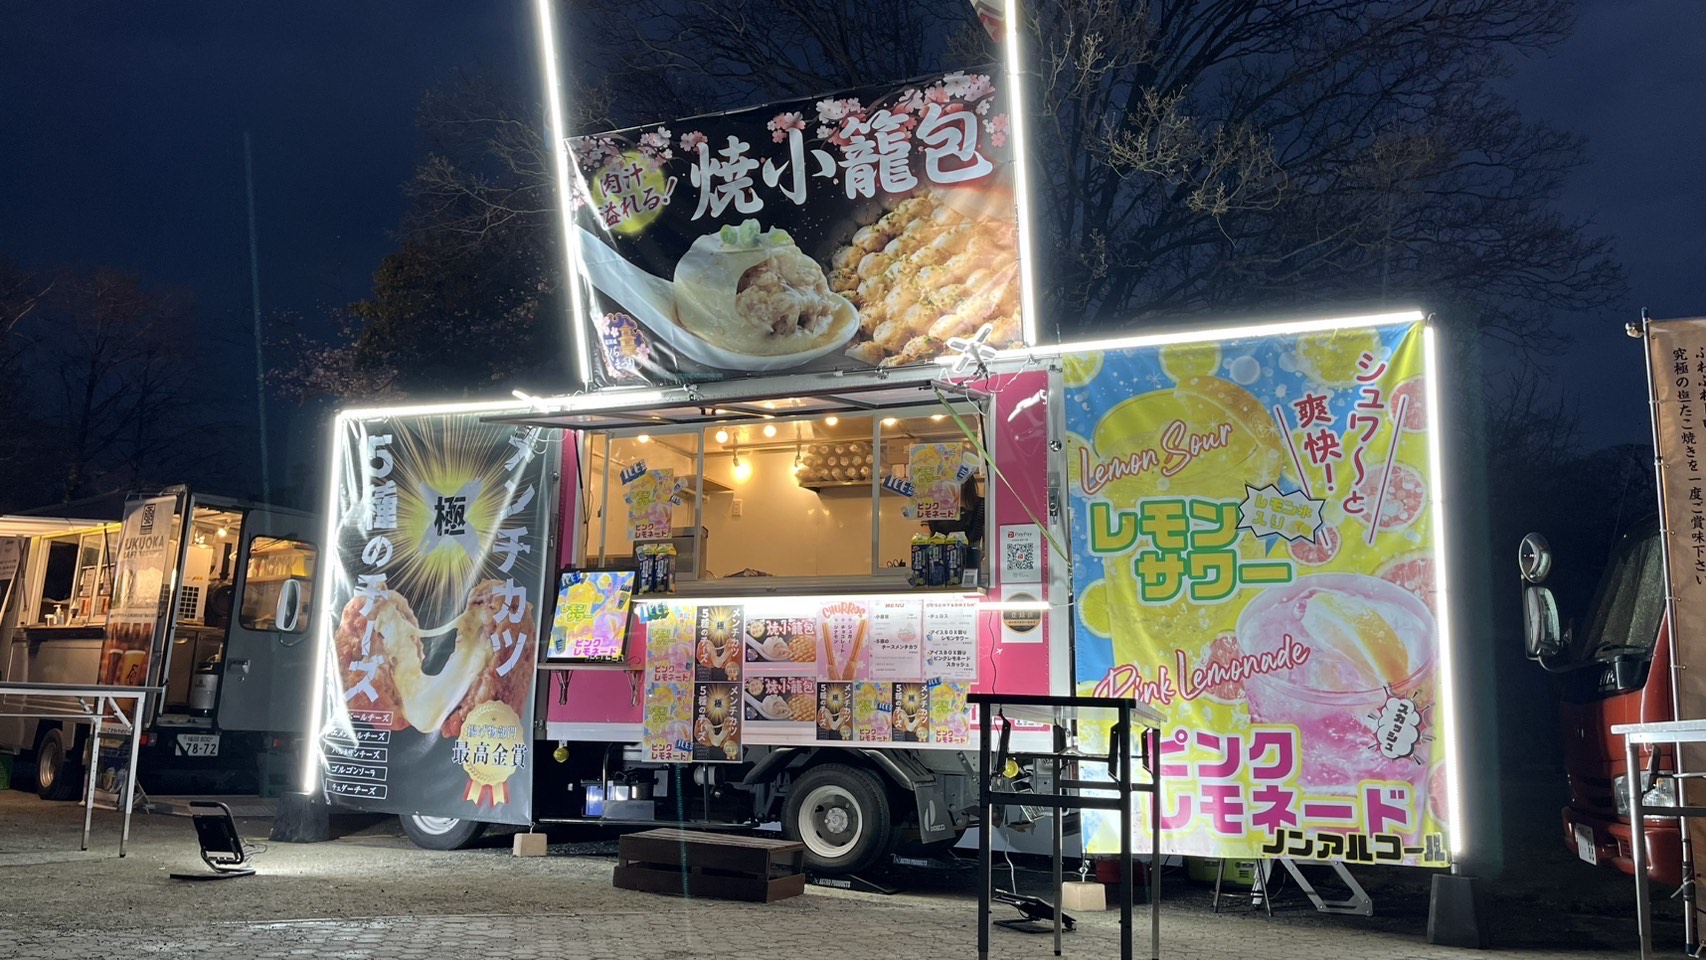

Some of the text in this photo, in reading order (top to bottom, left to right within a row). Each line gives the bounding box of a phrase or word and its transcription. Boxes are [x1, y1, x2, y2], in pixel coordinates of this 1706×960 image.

[690, 103, 993, 221] 焼小籠包
[600, 163, 643, 198] 肉汁
[1079, 418, 1233, 497] Lemon Sour
[433, 495, 467, 537] 極
[917, 502, 939, 511] ピンク
[917, 510, 955, 519] レモネード
[1251, 510, 1285, 530] 入り
[635, 523, 654, 531] ピンク
[635, 531, 667, 539] レモネード
[1090, 502, 1242, 553] レモン
[346, 433, 399, 703] 5種のチーズ
[490, 430, 537, 677] メンチカツ
[1136, 551, 1293, 603] サワー
[575, 639, 601, 647] ピンク
[731, 608, 741, 657] メンチカツ
[766, 619, 815, 636] 焼小籠包
[573, 648, 617, 656] レモネード
[1174, 634, 1311, 701] Lemonade
[765, 679, 815, 694] 焼小籠包
[1092, 664, 1177, 705] Pink
[729, 686, 738, 736] メンチカツ
[186, 743, 217, 755] 78-72
[452, 740, 528, 769] 最高金賞
[651, 743, 672, 751] ピンク
[651, 752, 687, 760] レモネード
[1146, 729, 1293, 780] ピンク
[1152, 784, 1408, 836] レモネード
[1262, 829, 1446, 862] ノンアルコール
